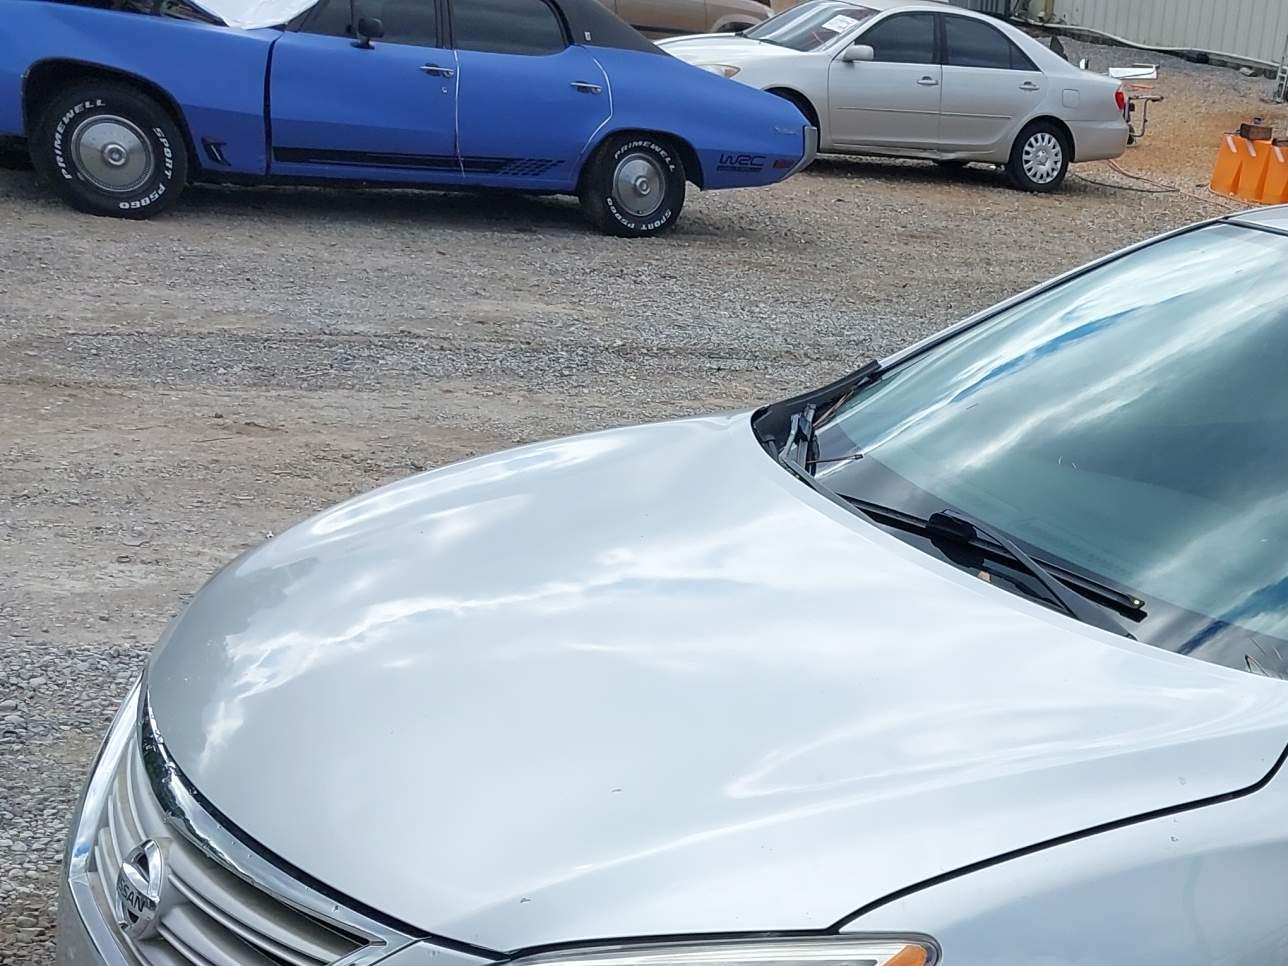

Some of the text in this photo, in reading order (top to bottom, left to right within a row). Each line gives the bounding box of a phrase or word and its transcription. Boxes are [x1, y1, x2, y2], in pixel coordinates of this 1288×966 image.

[54, 99, 106, 179] PRIMEWELL
[152, 127, 173, 179] SPORT
[614, 140, 676, 173] PRIMEWELL
[719, 153, 768, 166] WRC
[640, 209, 673, 231] SPORT
